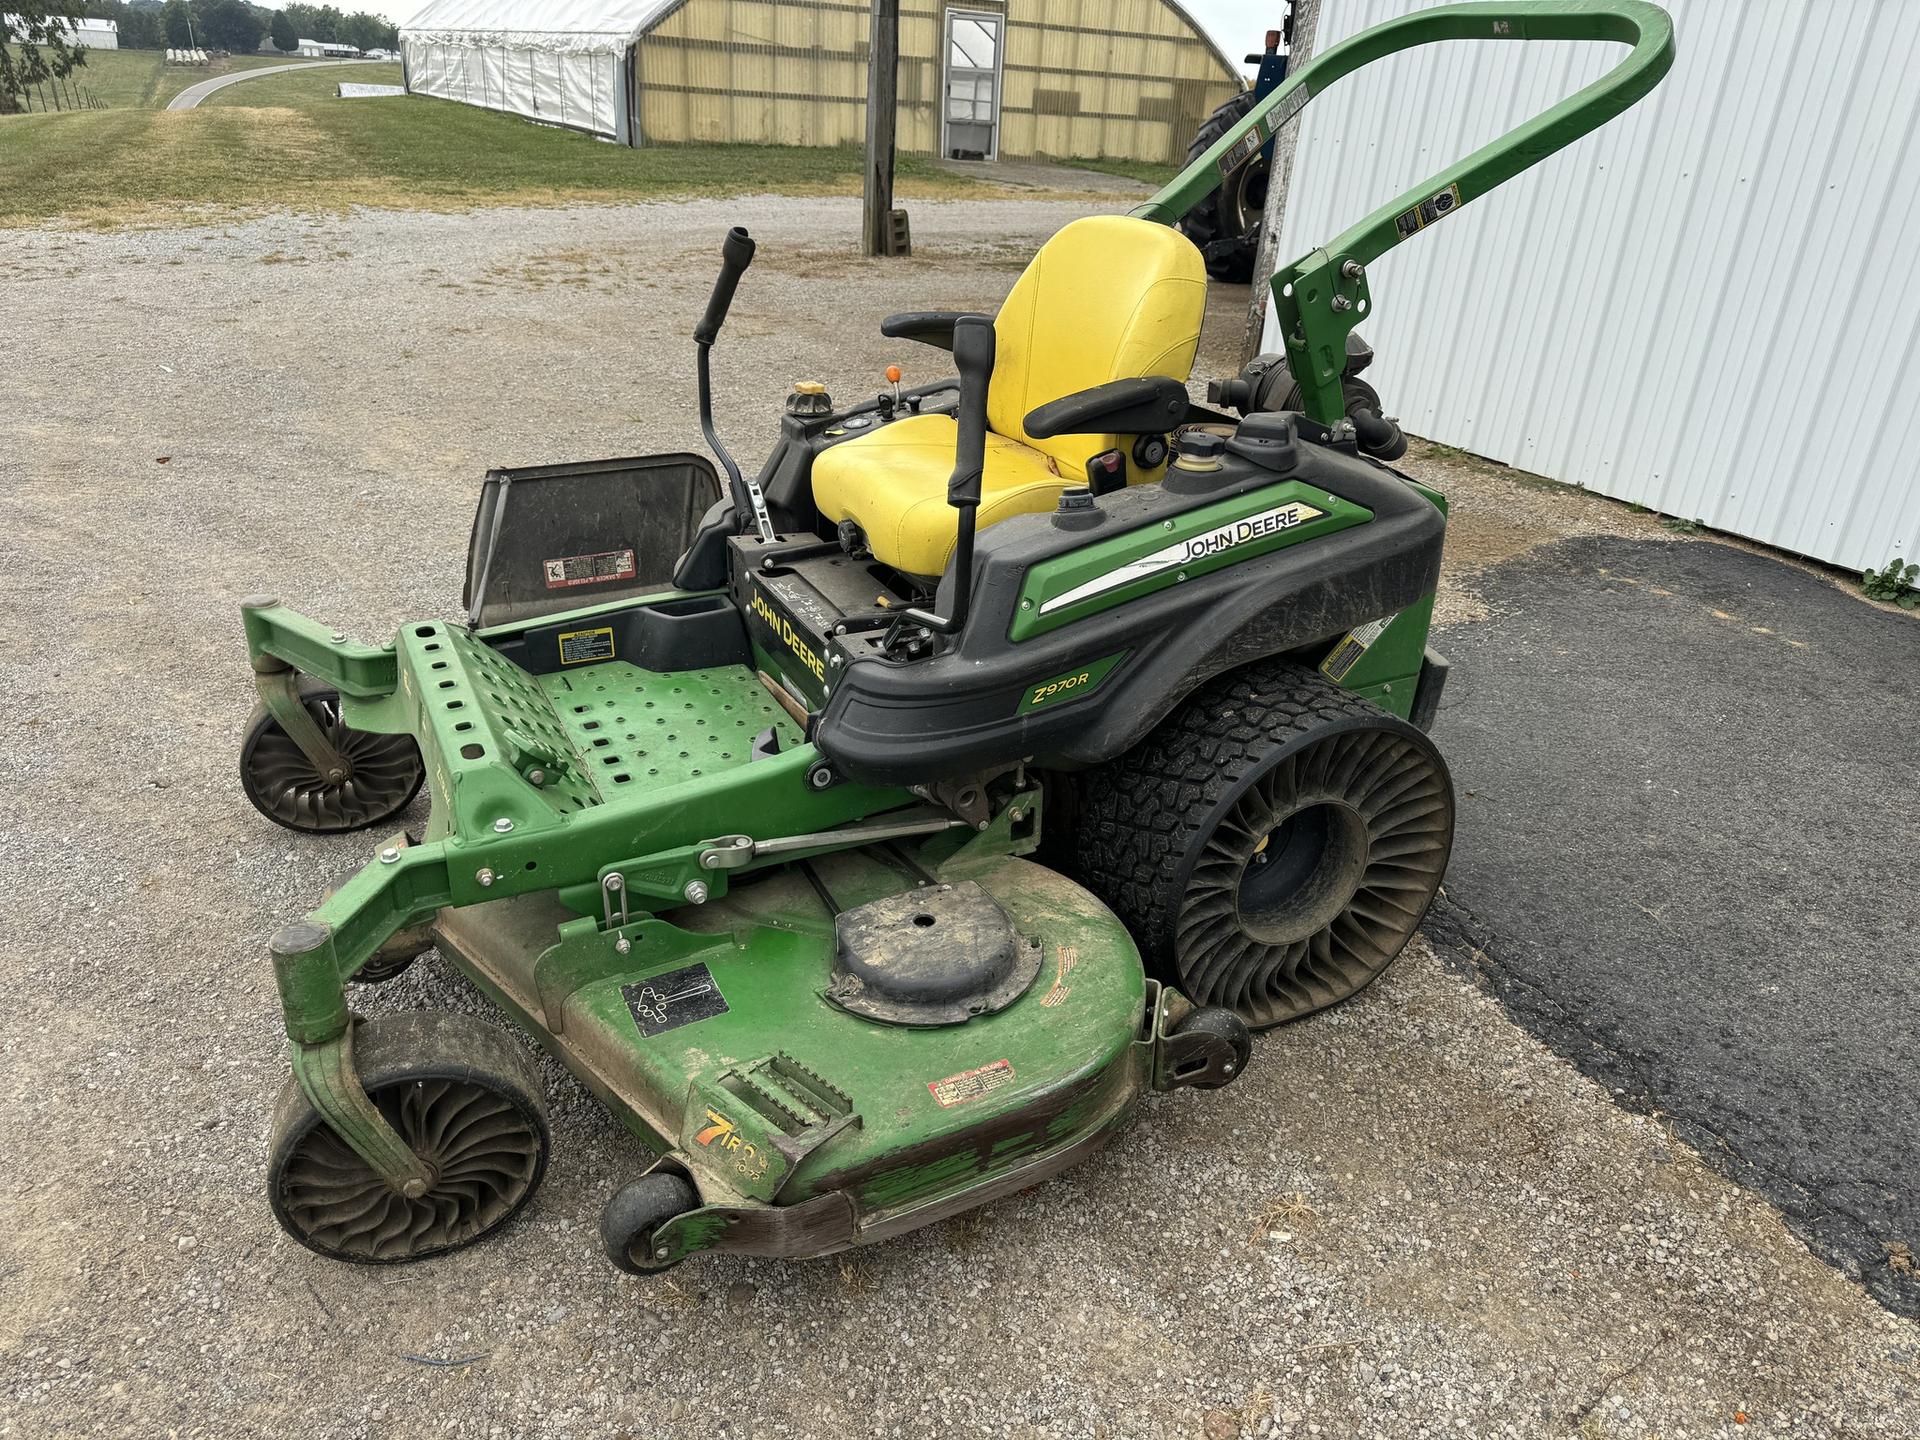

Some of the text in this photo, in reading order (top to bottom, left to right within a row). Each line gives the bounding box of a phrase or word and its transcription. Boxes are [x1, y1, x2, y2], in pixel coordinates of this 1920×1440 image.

[1181, 507, 1299, 562] JOHN DEERE
[750, 587, 782, 637] JOHN
[782, 619, 826, 683] DEERE
[1031, 672, 1090, 705] Z970R
